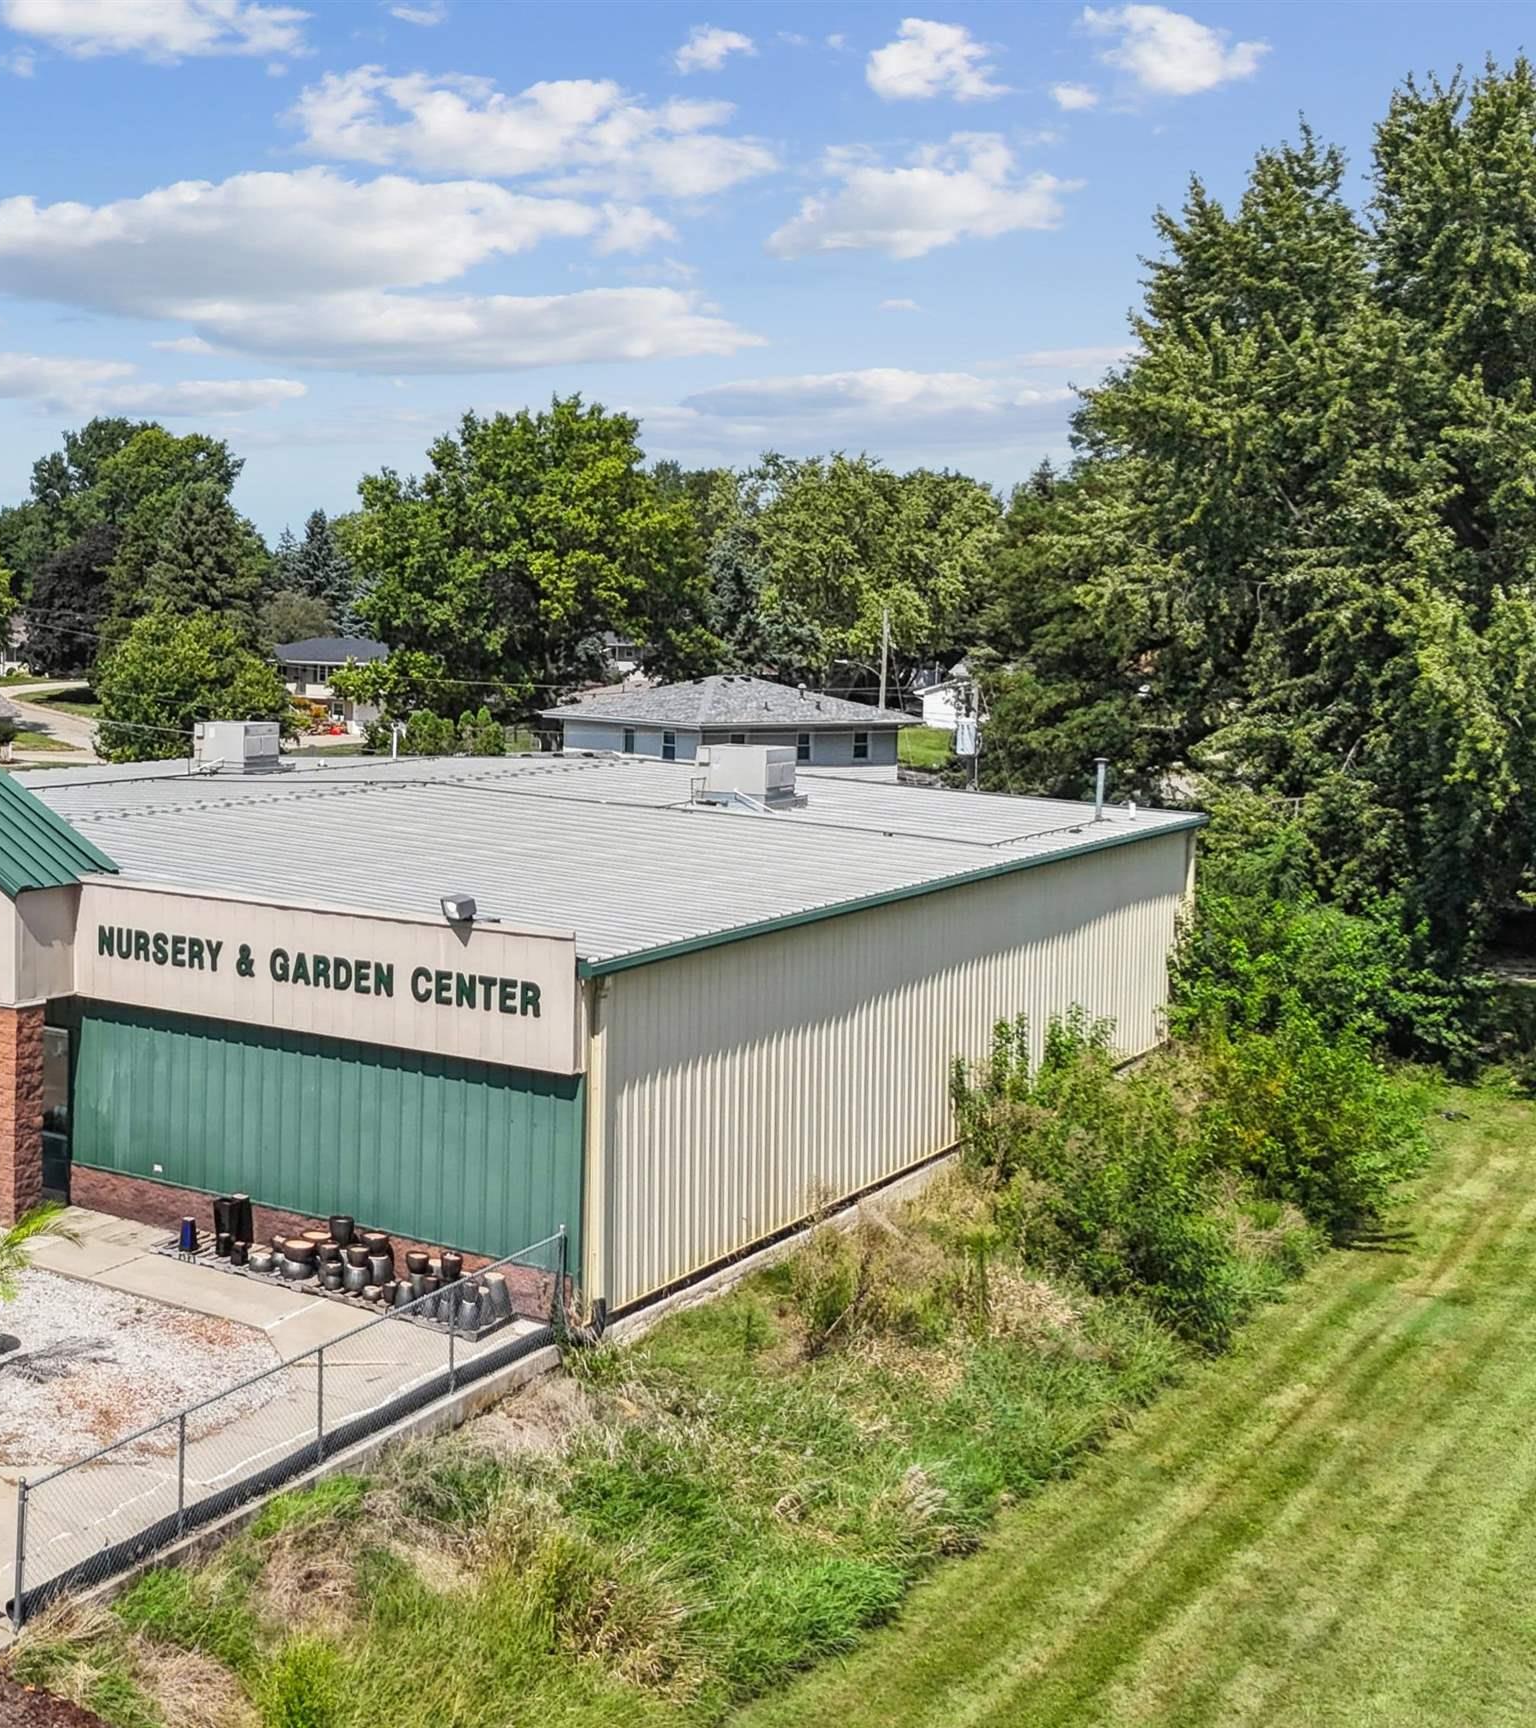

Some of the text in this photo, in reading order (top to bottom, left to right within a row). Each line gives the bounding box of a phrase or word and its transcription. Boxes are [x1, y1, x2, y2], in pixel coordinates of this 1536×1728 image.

[97, 924, 542, 1018] NURSERY & GARDEN CENTER
